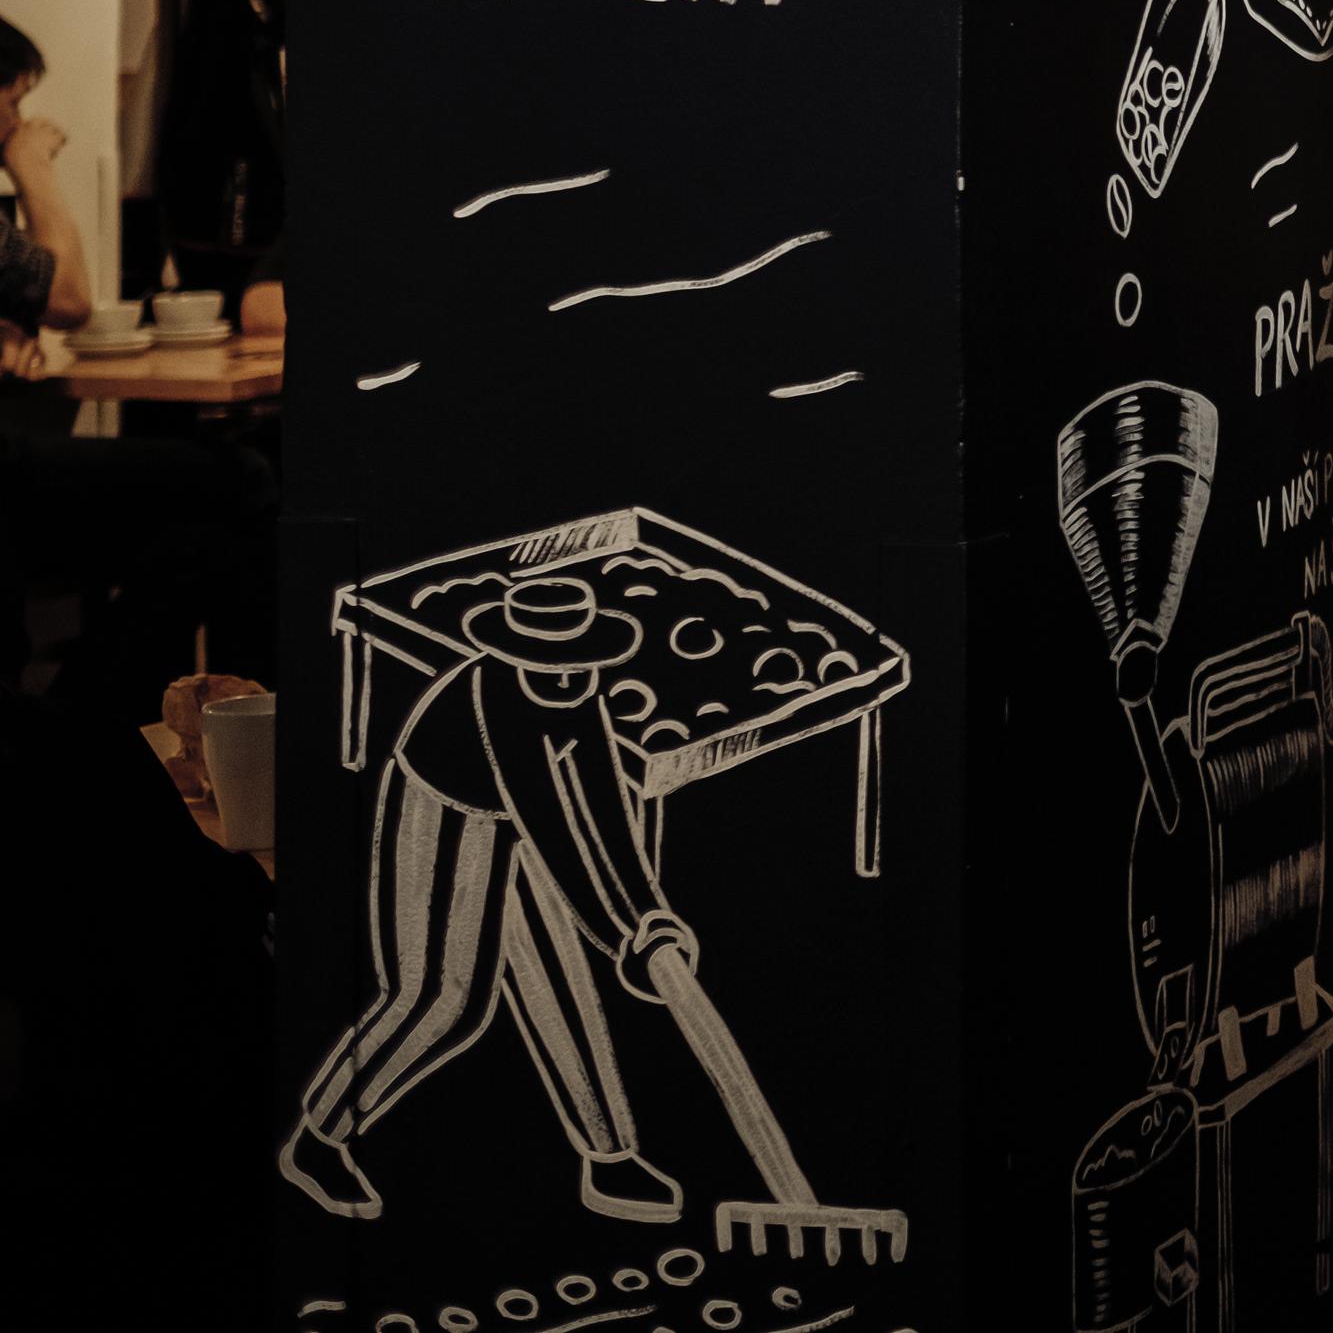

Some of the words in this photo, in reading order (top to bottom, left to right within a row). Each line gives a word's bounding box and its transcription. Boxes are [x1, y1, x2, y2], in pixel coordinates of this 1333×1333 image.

[1256, 495, 1271, 548] V
[1281, 448, 1320, 533] NAŠÍ
[1304, 539, 1328, 601] NA
